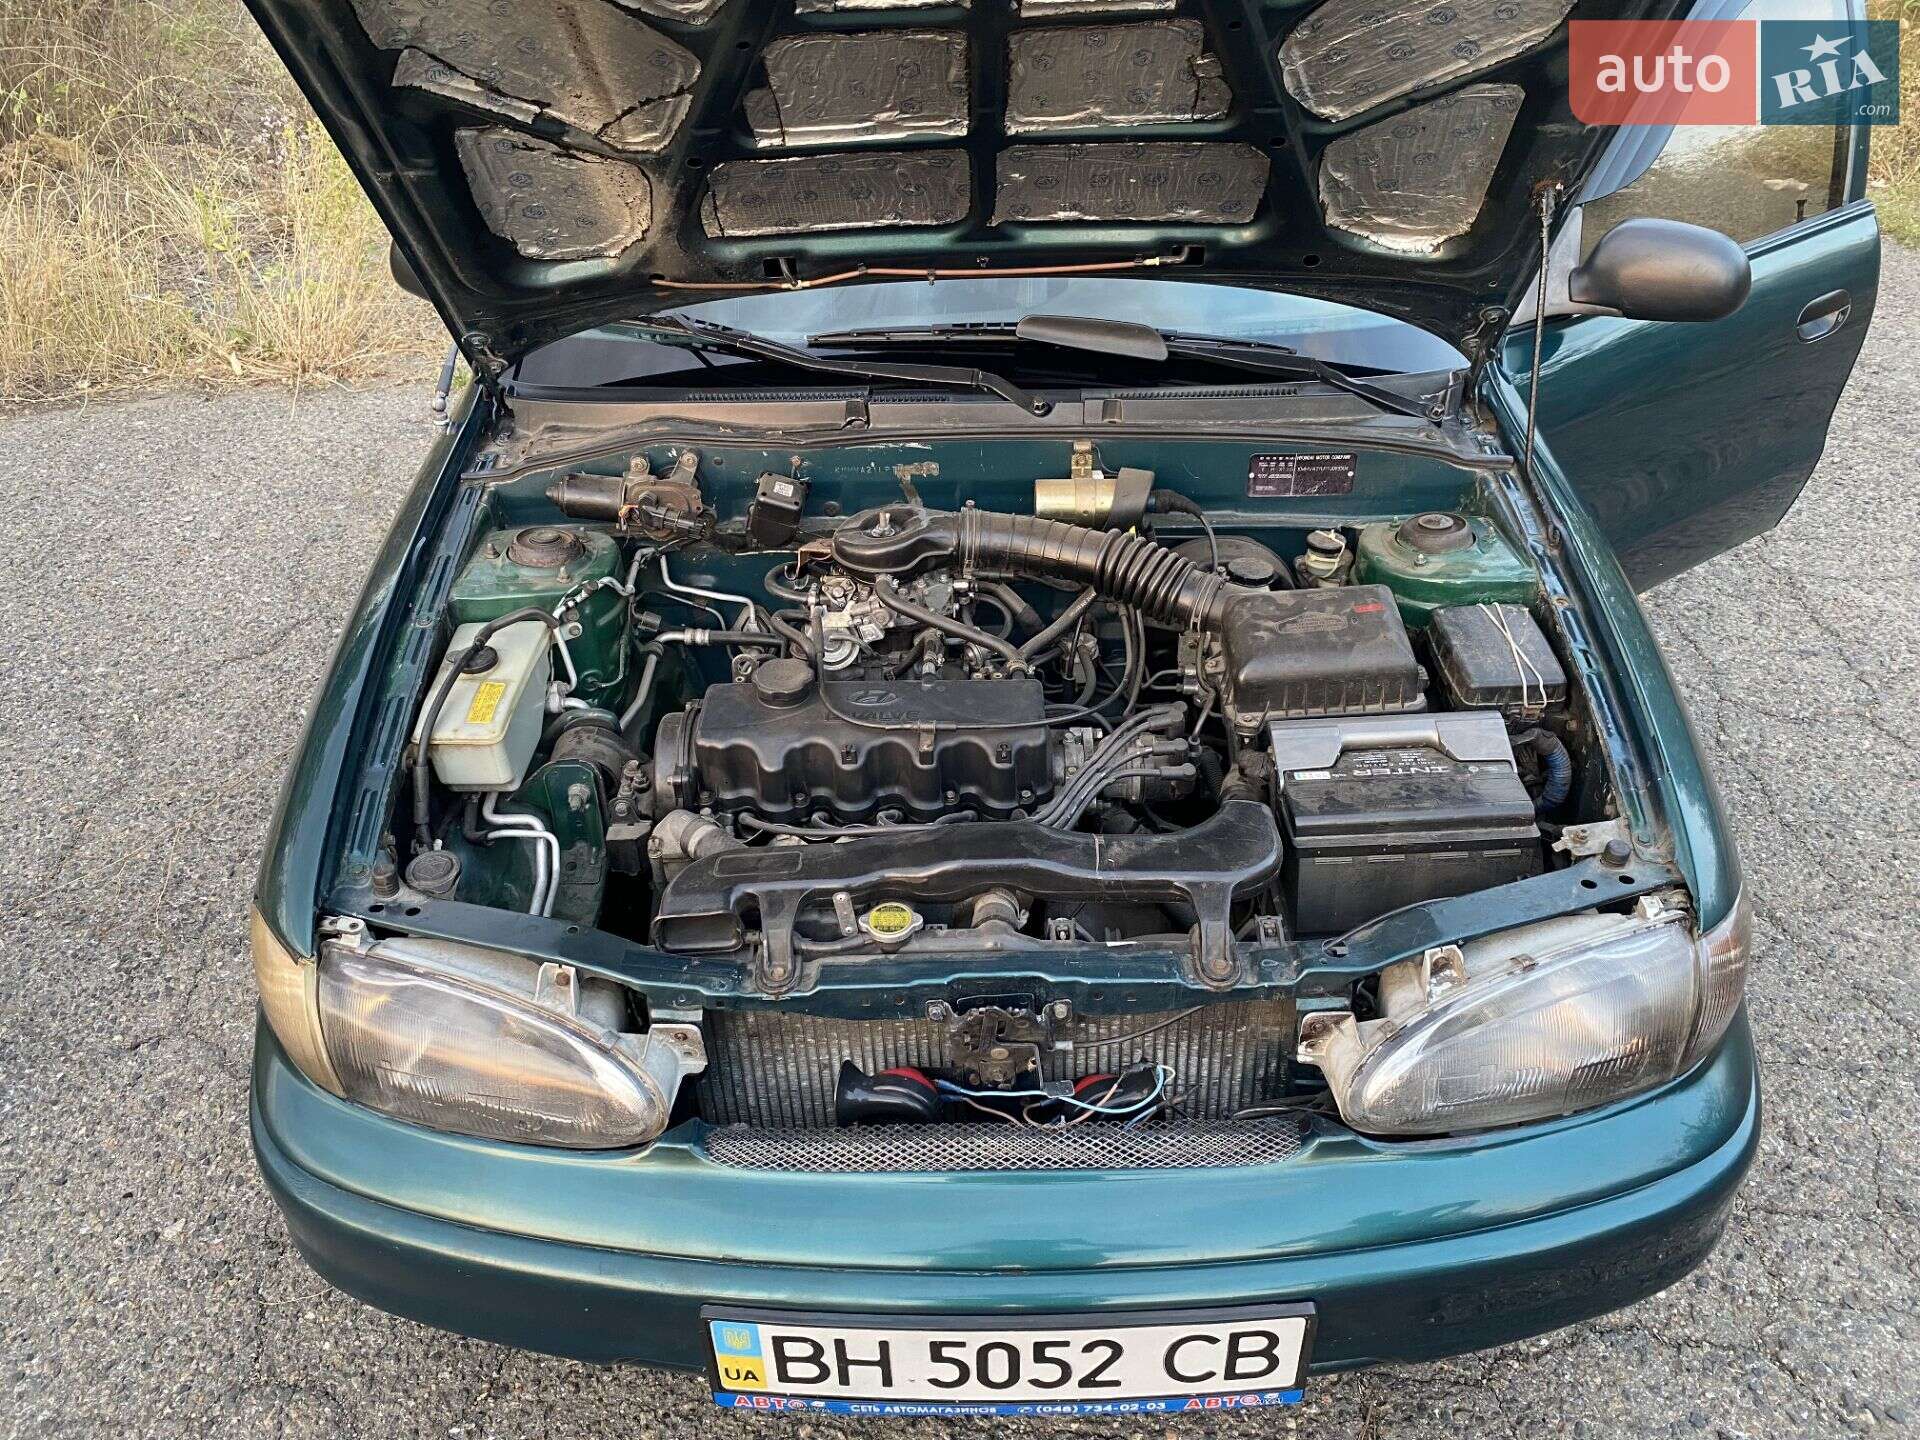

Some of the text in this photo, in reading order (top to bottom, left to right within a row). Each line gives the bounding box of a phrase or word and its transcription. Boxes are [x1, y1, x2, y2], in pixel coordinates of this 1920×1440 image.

[771, 1330, 1280, 1389] BH 5052 CB
[724, 1367, 760, 1382] UA
[851, 1404, 997, 1414] СЕТЬ АВТОМАГАЗИНОВ
[1084, 1402, 1166, 1413] 734-02-03
